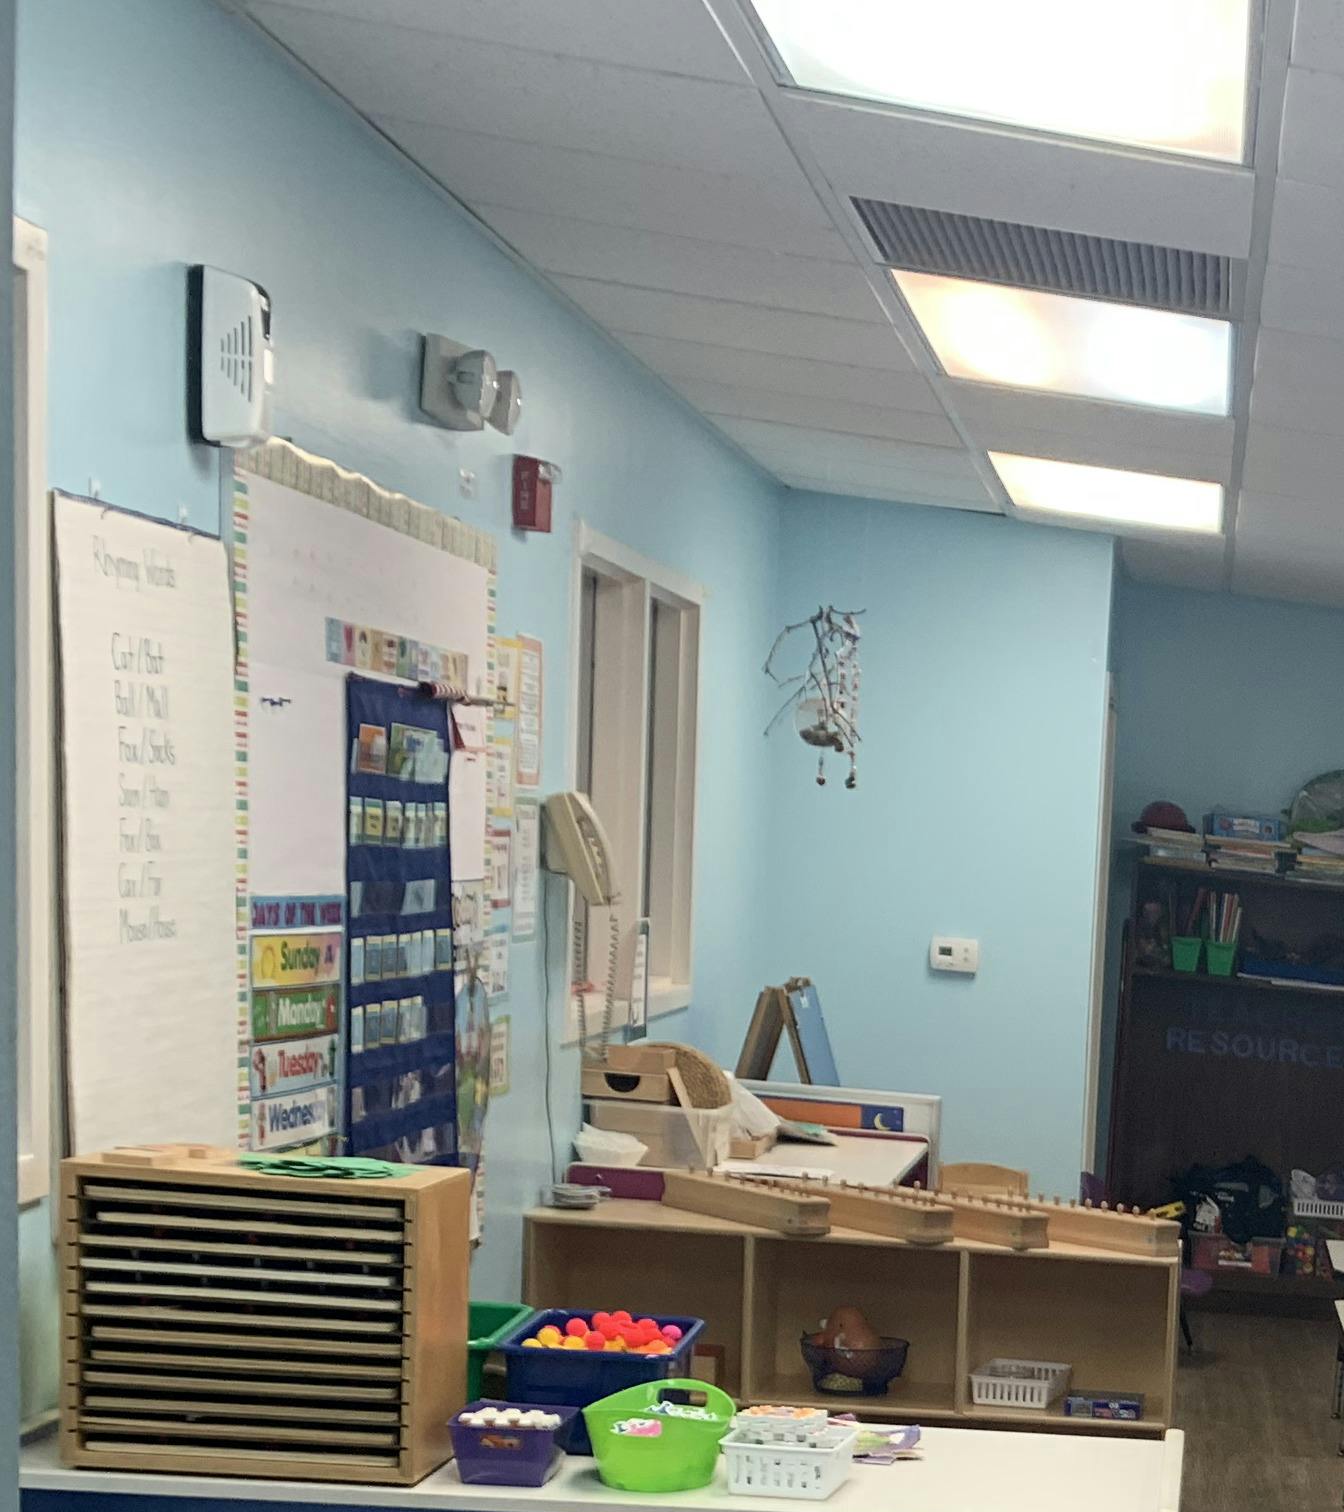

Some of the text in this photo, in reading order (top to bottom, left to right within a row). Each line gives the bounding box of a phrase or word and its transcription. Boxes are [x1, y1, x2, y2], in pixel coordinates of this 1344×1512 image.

[252, 901, 280, 927] DAYS
[280, 939, 321, 977] Sunday
[277, 993, 326, 1029] Monday
[277, 1043, 324, 1080] Tuesday
[268, 1093, 325, 1134] Wednes
